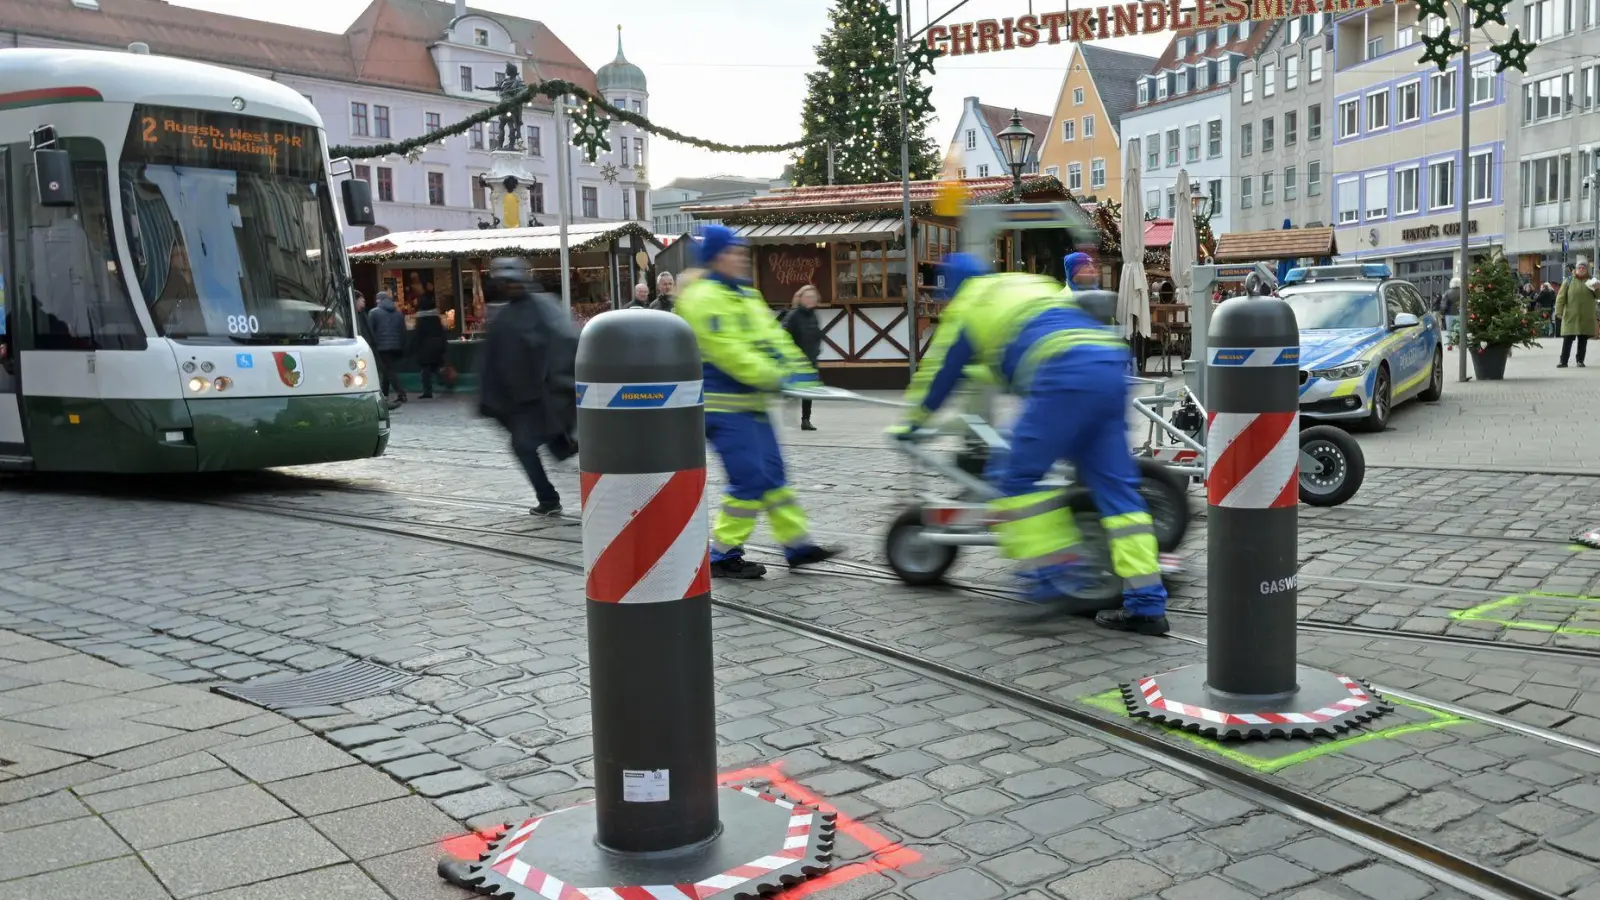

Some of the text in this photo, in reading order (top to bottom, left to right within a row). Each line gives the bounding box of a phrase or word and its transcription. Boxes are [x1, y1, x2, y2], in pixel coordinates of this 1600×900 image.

[927, 0, 1410, 57] CHRISTKINDLESM
[142, 117, 158, 143] 2
[164, 120, 303, 148] Augsb. West P+R
[212, 138, 278, 157] Uniklinik
[769, 252, 820, 271] Knusper
[227, 315, 259, 334] 880
